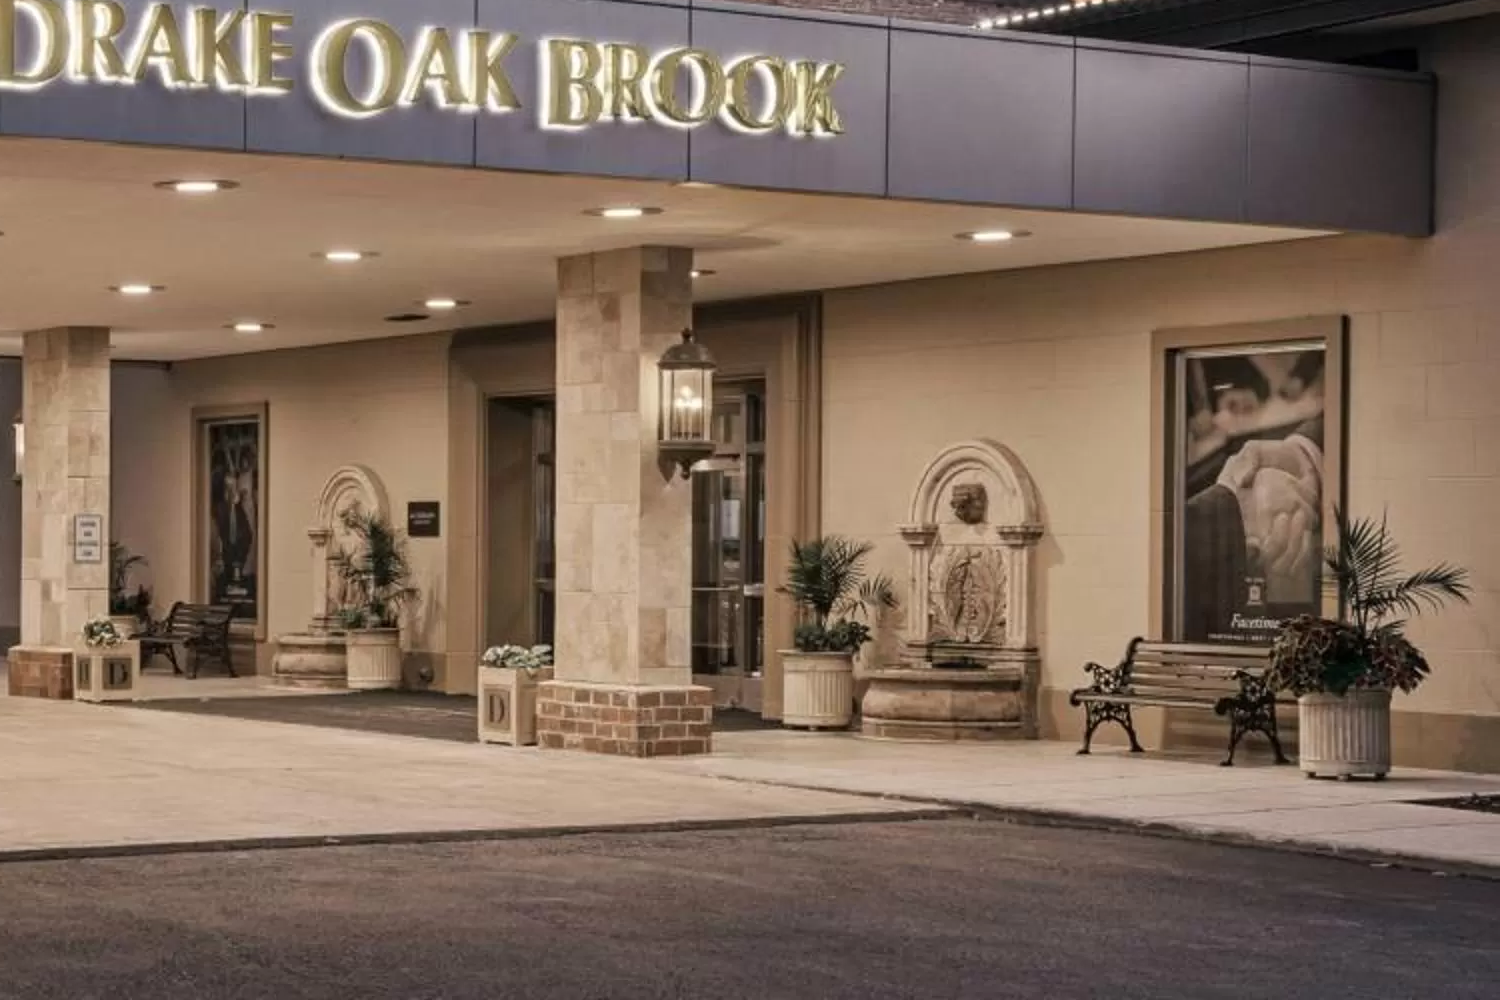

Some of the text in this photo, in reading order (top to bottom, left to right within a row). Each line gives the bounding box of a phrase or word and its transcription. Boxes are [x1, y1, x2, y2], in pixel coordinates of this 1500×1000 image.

[308, 18, 522, 120] OAK
[537, 37, 845, 138] BROOK
[488, 694, 505, 724] D
